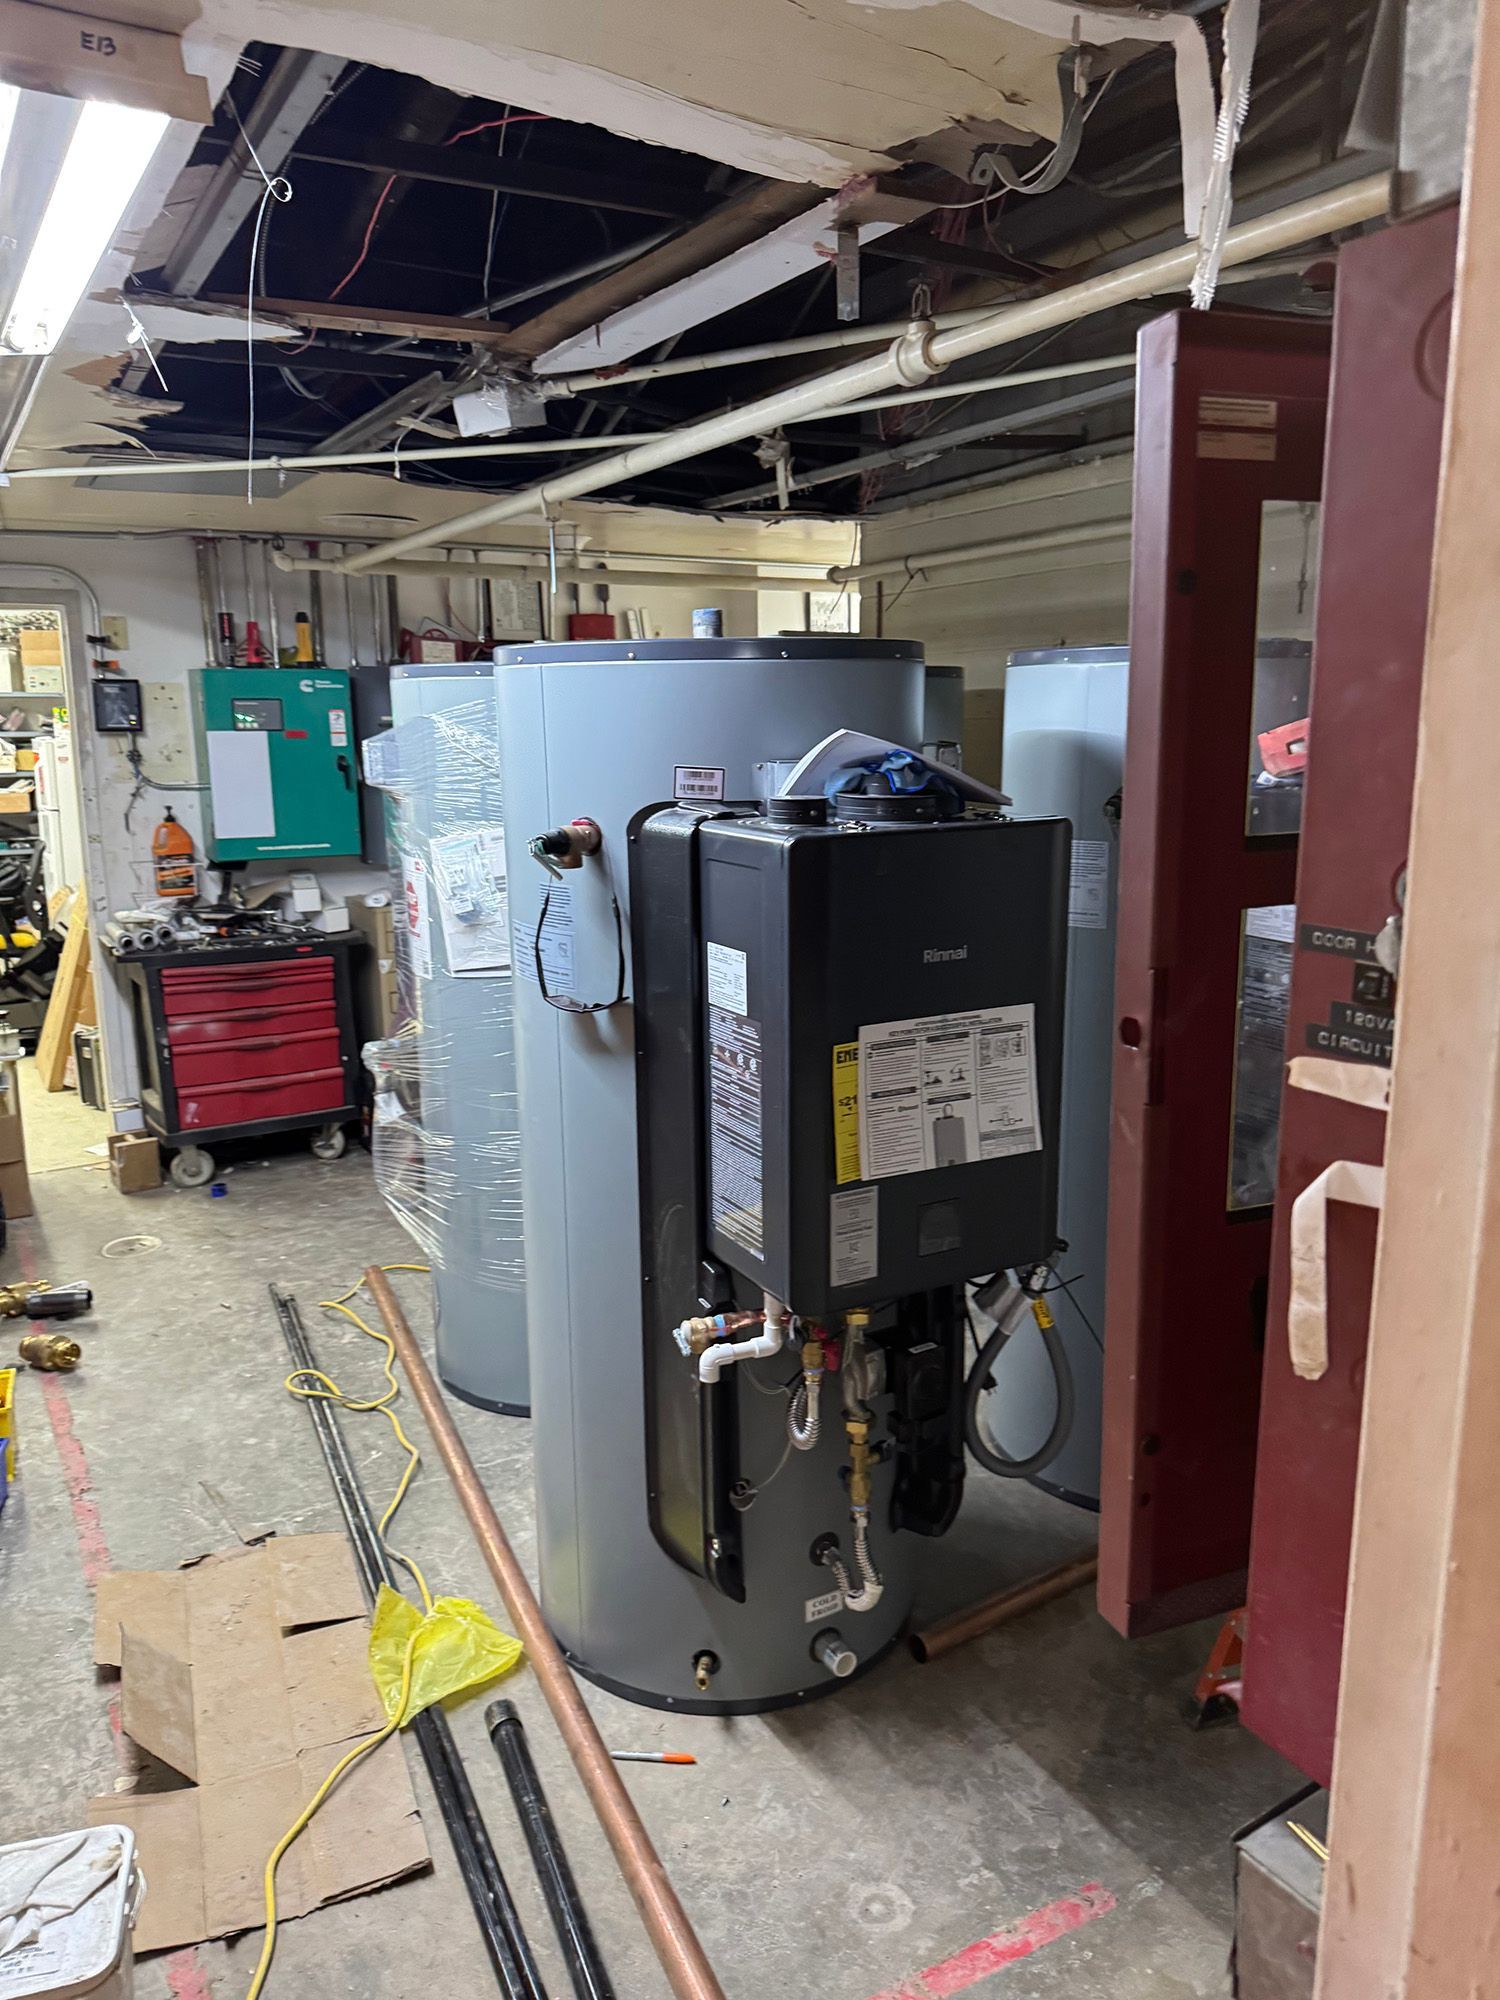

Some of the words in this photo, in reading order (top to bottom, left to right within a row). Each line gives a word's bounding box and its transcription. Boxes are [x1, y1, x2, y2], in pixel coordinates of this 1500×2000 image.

[1311, 931, 1356, 950] DOOR
[923, 944, 968, 963] Rinnai
[1317, 1031, 1393, 1058] CIRCUIT
[811, 1602, 840, 1619] FROID
[812, 1593, 839, 1609] COLD
